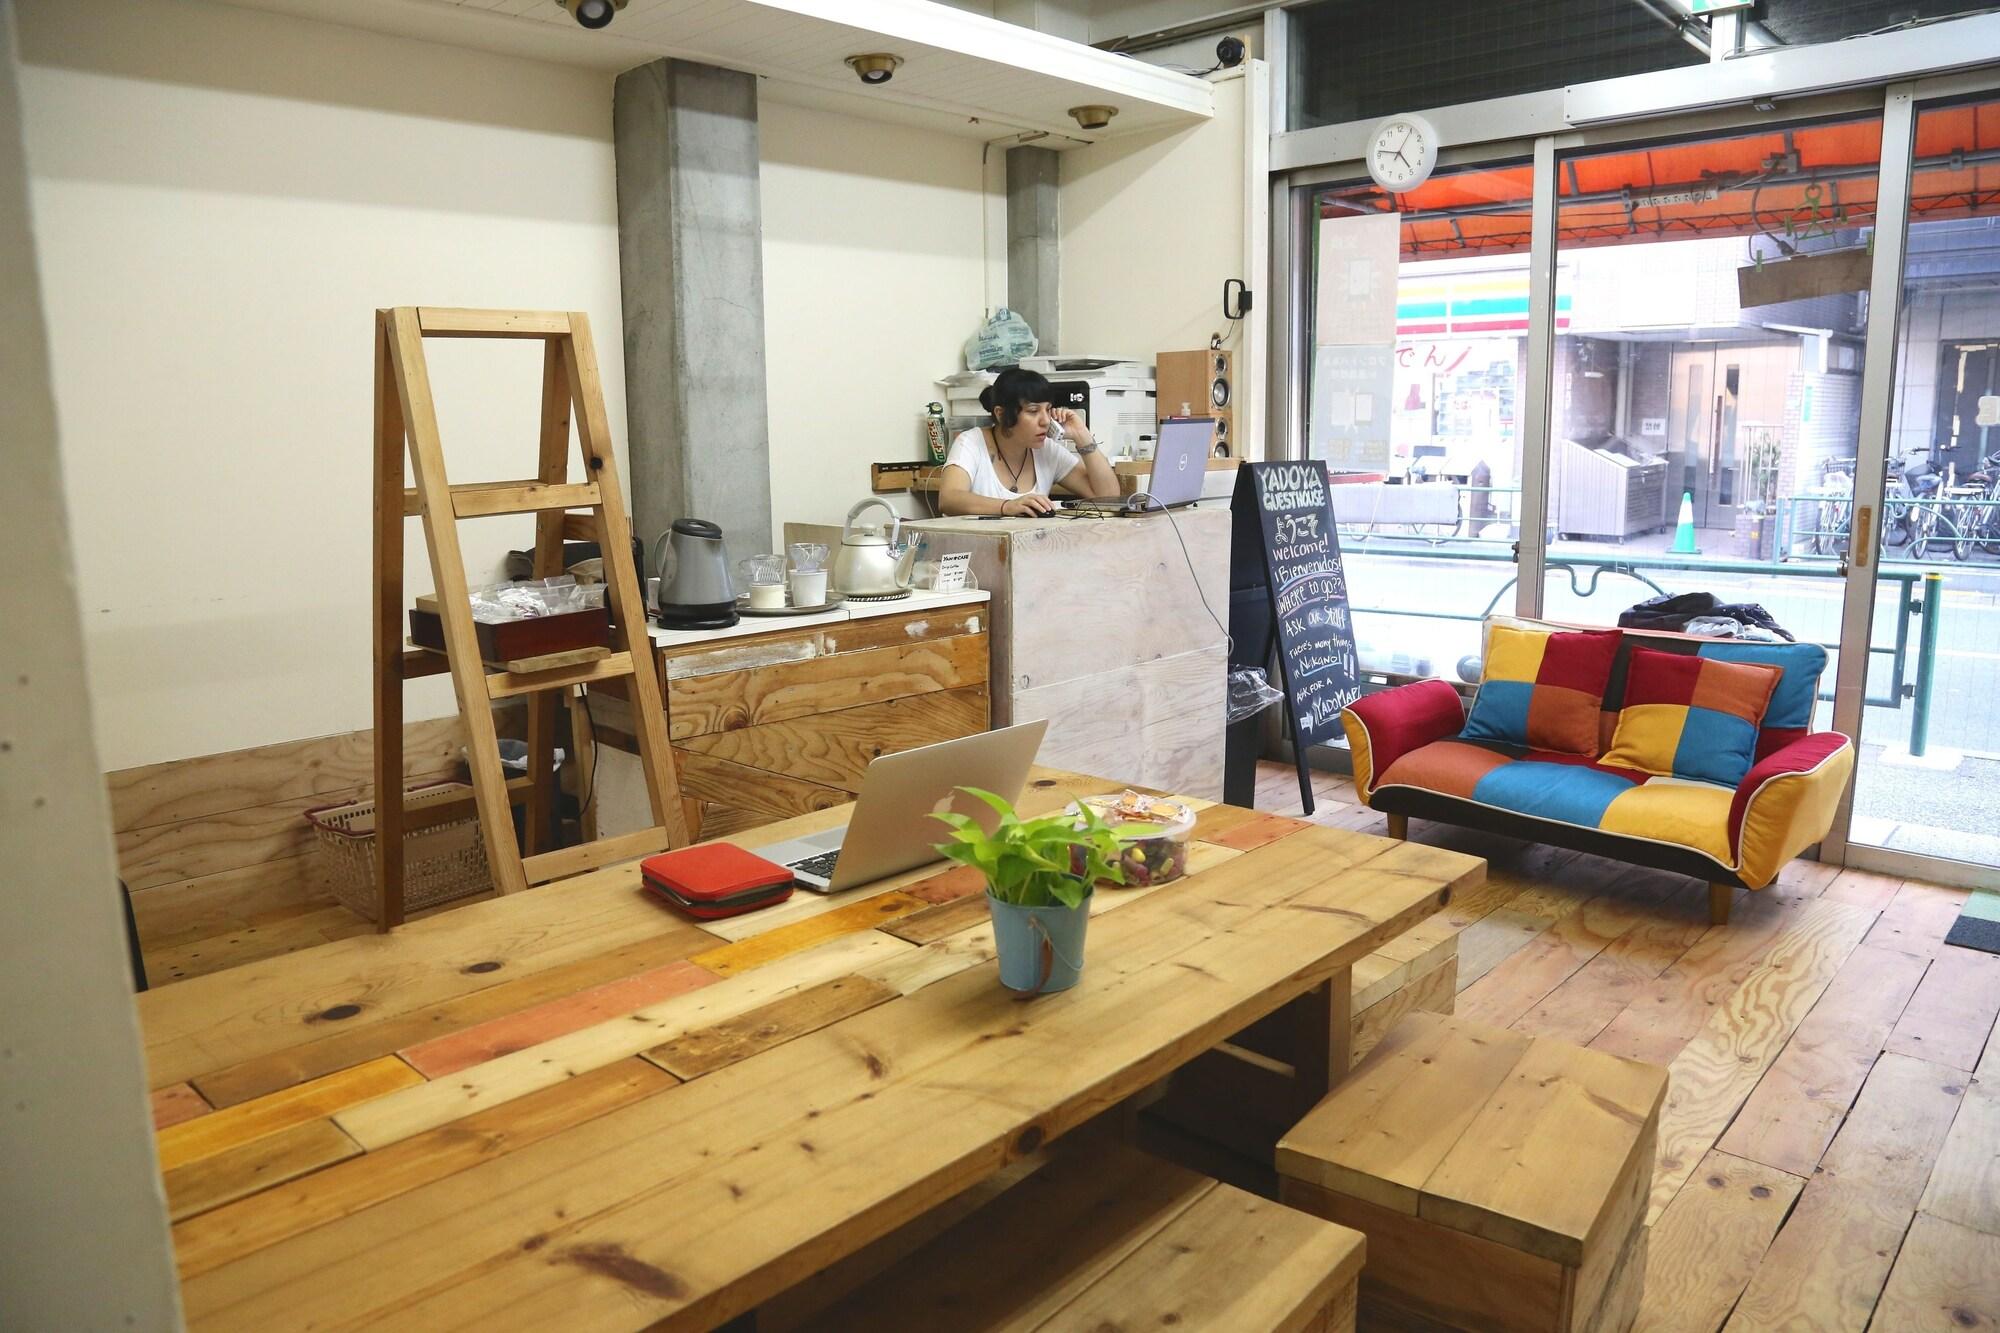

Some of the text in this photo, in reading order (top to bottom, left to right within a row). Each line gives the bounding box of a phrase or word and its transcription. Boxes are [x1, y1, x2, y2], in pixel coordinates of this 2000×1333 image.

[1256, 465, 1323, 493] YADOYA
[1263, 488, 1326, 511] GUESTHOUSE
[1275, 513, 1319, 544] ようこそ
[1308, 580, 1319, 595] to
[1285, 617, 1306, 637] ASK
[1296, 677, 1333, 704] ASK FOR A
